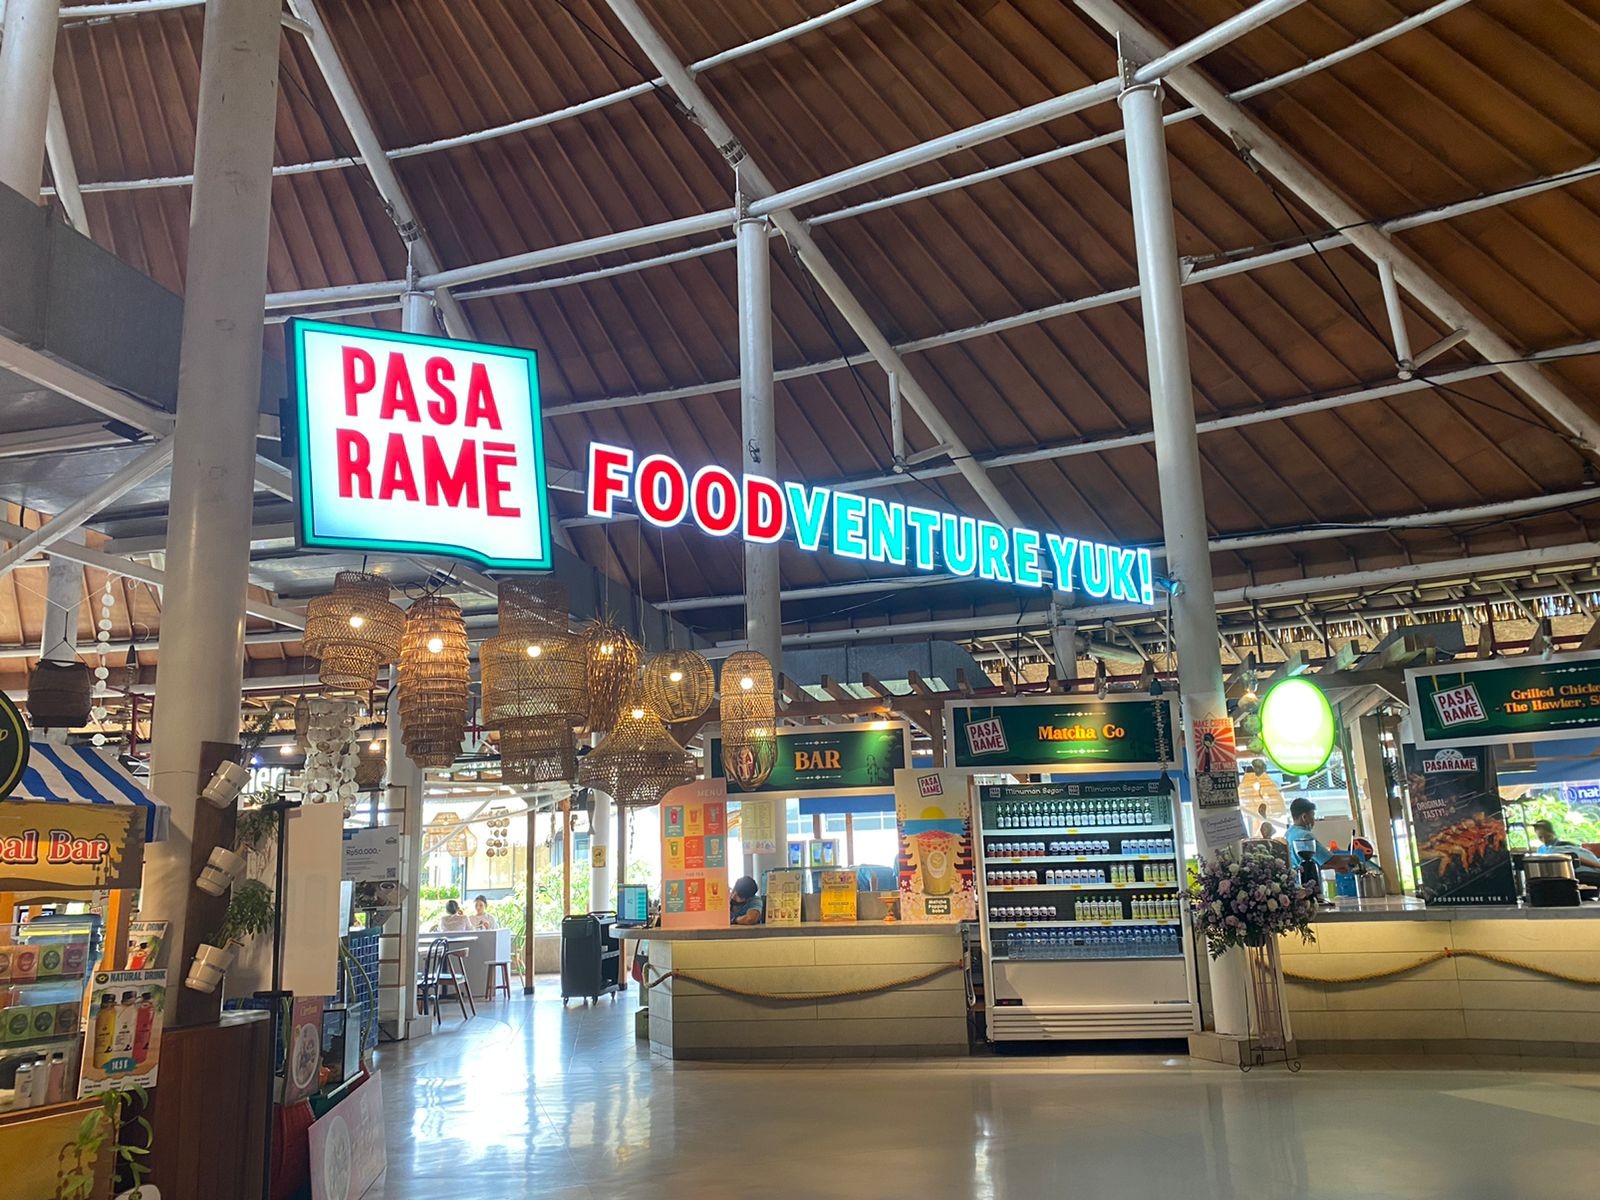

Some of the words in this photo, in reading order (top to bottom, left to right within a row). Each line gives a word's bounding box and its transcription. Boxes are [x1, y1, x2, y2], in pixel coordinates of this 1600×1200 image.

[341, 345, 503, 430] PASA
[1046, 533, 1154, 605] YUK!
[1438, 688, 1474, 709] PASA
[1511, 687, 1555, 700] Grilled
[1504, 702, 1528, 713] The
[969, 721, 999, 740] PASA
[1193, 719, 1209, 727] MAKE
[1210, 718, 1232, 727] COFFEE
[1038, 724, 1097, 741] Matcha
[1103, 723, 1125, 739] Go
[794, 750, 842, 771] BAR
[920, 776, 938, 787] PASA
[697, 788, 722, 797] MENU
[48, 830, 109, 863] Bar
[110, 972, 142, 982] NATURAL
[144, 970, 166, 980] DRINK
